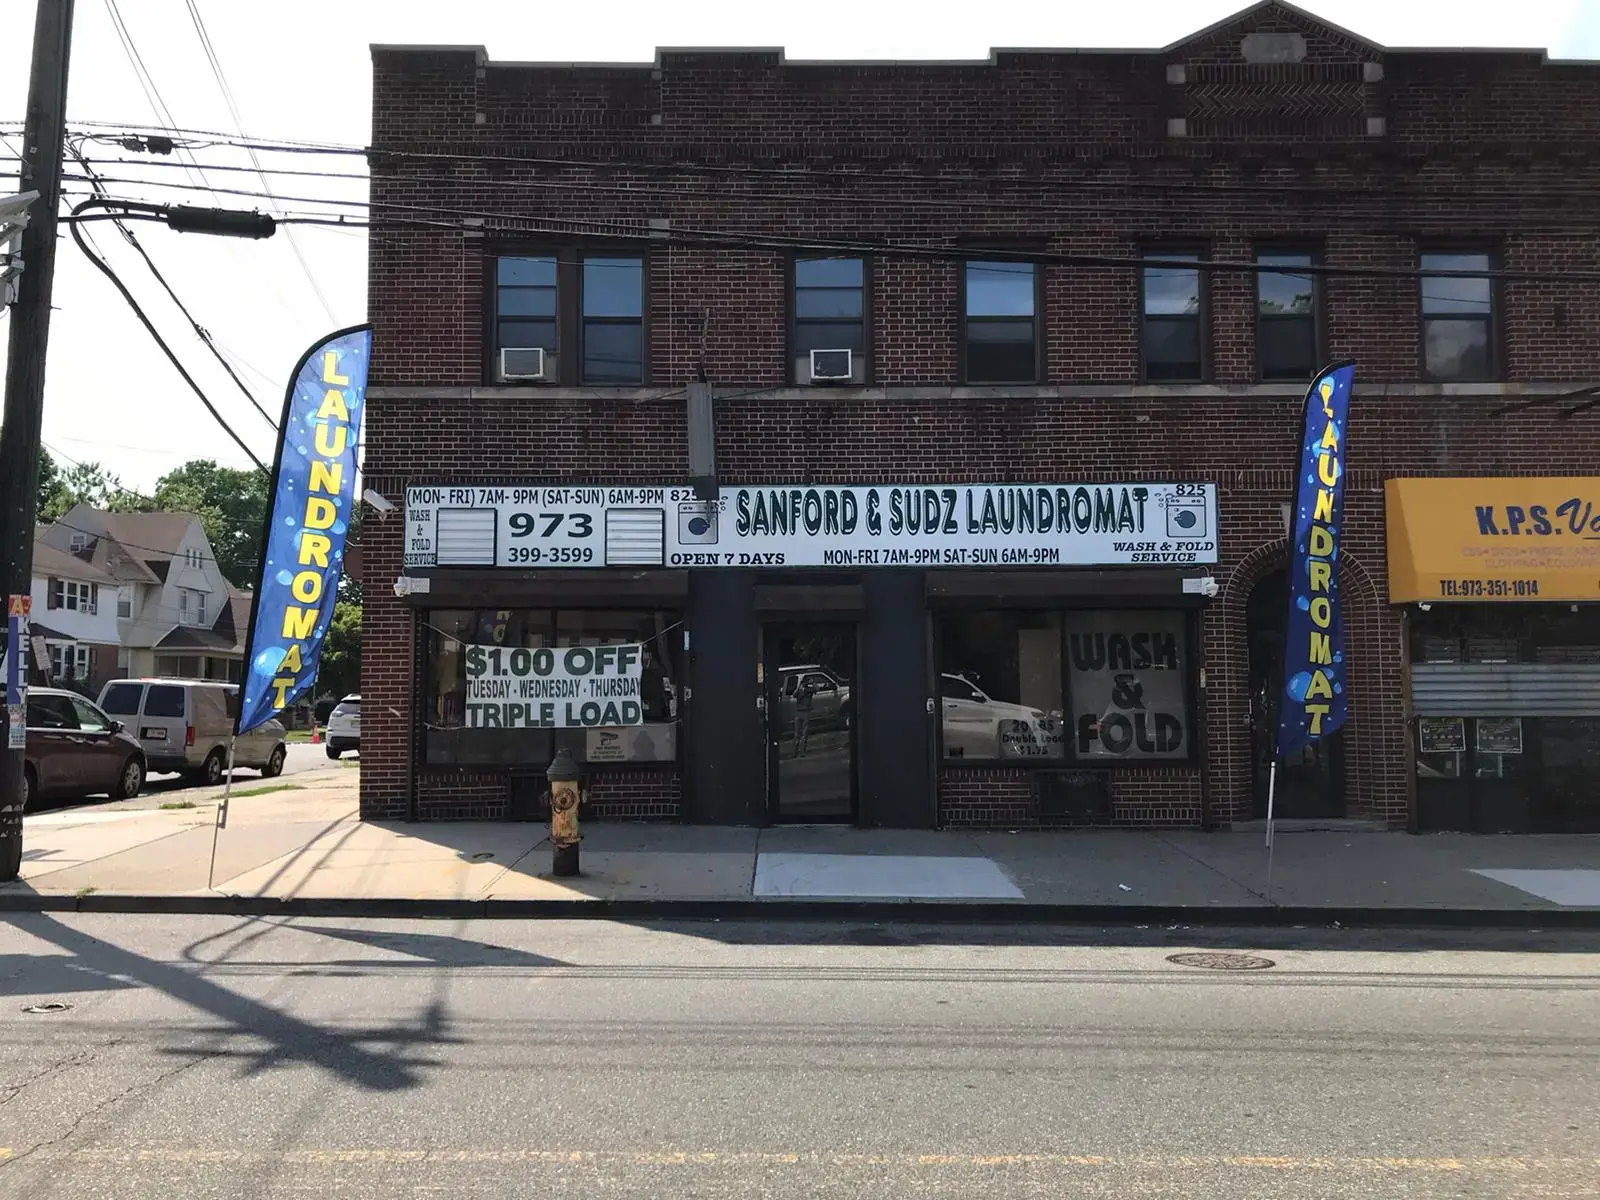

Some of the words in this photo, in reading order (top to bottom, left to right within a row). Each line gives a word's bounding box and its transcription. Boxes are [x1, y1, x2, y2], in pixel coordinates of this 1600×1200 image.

[449, 489, 475, 507] FRI)
[514, 489, 538, 504] 9PM
[543, 489, 605, 507] (SAT-SUN)
[608, 489, 664, 504] 6AM-9PM
[1176, 484, 1206, 496] 825
[409, 510, 430, 522] WASH
[736, 488, 858, 537] SANFORD
[866, 488, 882, 536] &
[889, 488, 958, 536] SUDZ
[966, 487, 1148, 535] LAUNDROMAT
[1475, 505, 1562, 536] K.P.S.
[272, 352, 349, 709] LAUNDROMAT
[417, 524, 424, 536] &
[508, 512, 594, 538] 973
[411, 538, 431, 551] FOLD
[1113, 542, 1157, 552] WASH
[1159, 542, 1173, 552] &
[1176, 541, 1214, 551] FOLD
[403, 552, 436, 566] SERVICE
[508, 547, 593, 563] 399-3599
[671, 553, 721, 566] OPEN
[725, 553, 734, 565] 7
[739, 552, 785, 565] DAYS
[824, 549, 879, 565] MON-FRI
[883, 549, 940, 564] 7AM-9PM
[944, 549, 998, 564] SAT-SUN
[1001, 548, 1060, 563] 6AM-9PM
[1131, 552, 1196, 562] SERVICE
[16, 616, 30, 705] KELLY
[466, 645, 555, 678] $1.00
[564, 646, 639, 676] OFF
[1070, 632, 1177, 672] WASH
[467, 679, 511, 698] TUESDAY
[519, 678, 580, 698] WEDNESDAY
[590, 678, 641, 697] THURSDAY
[1112, 674, 1147, 710] &
[467, 701, 555, 728] TRIPLE
[565, 701, 641, 726] LOAD
[1078, 712, 1183, 753] FOLD
